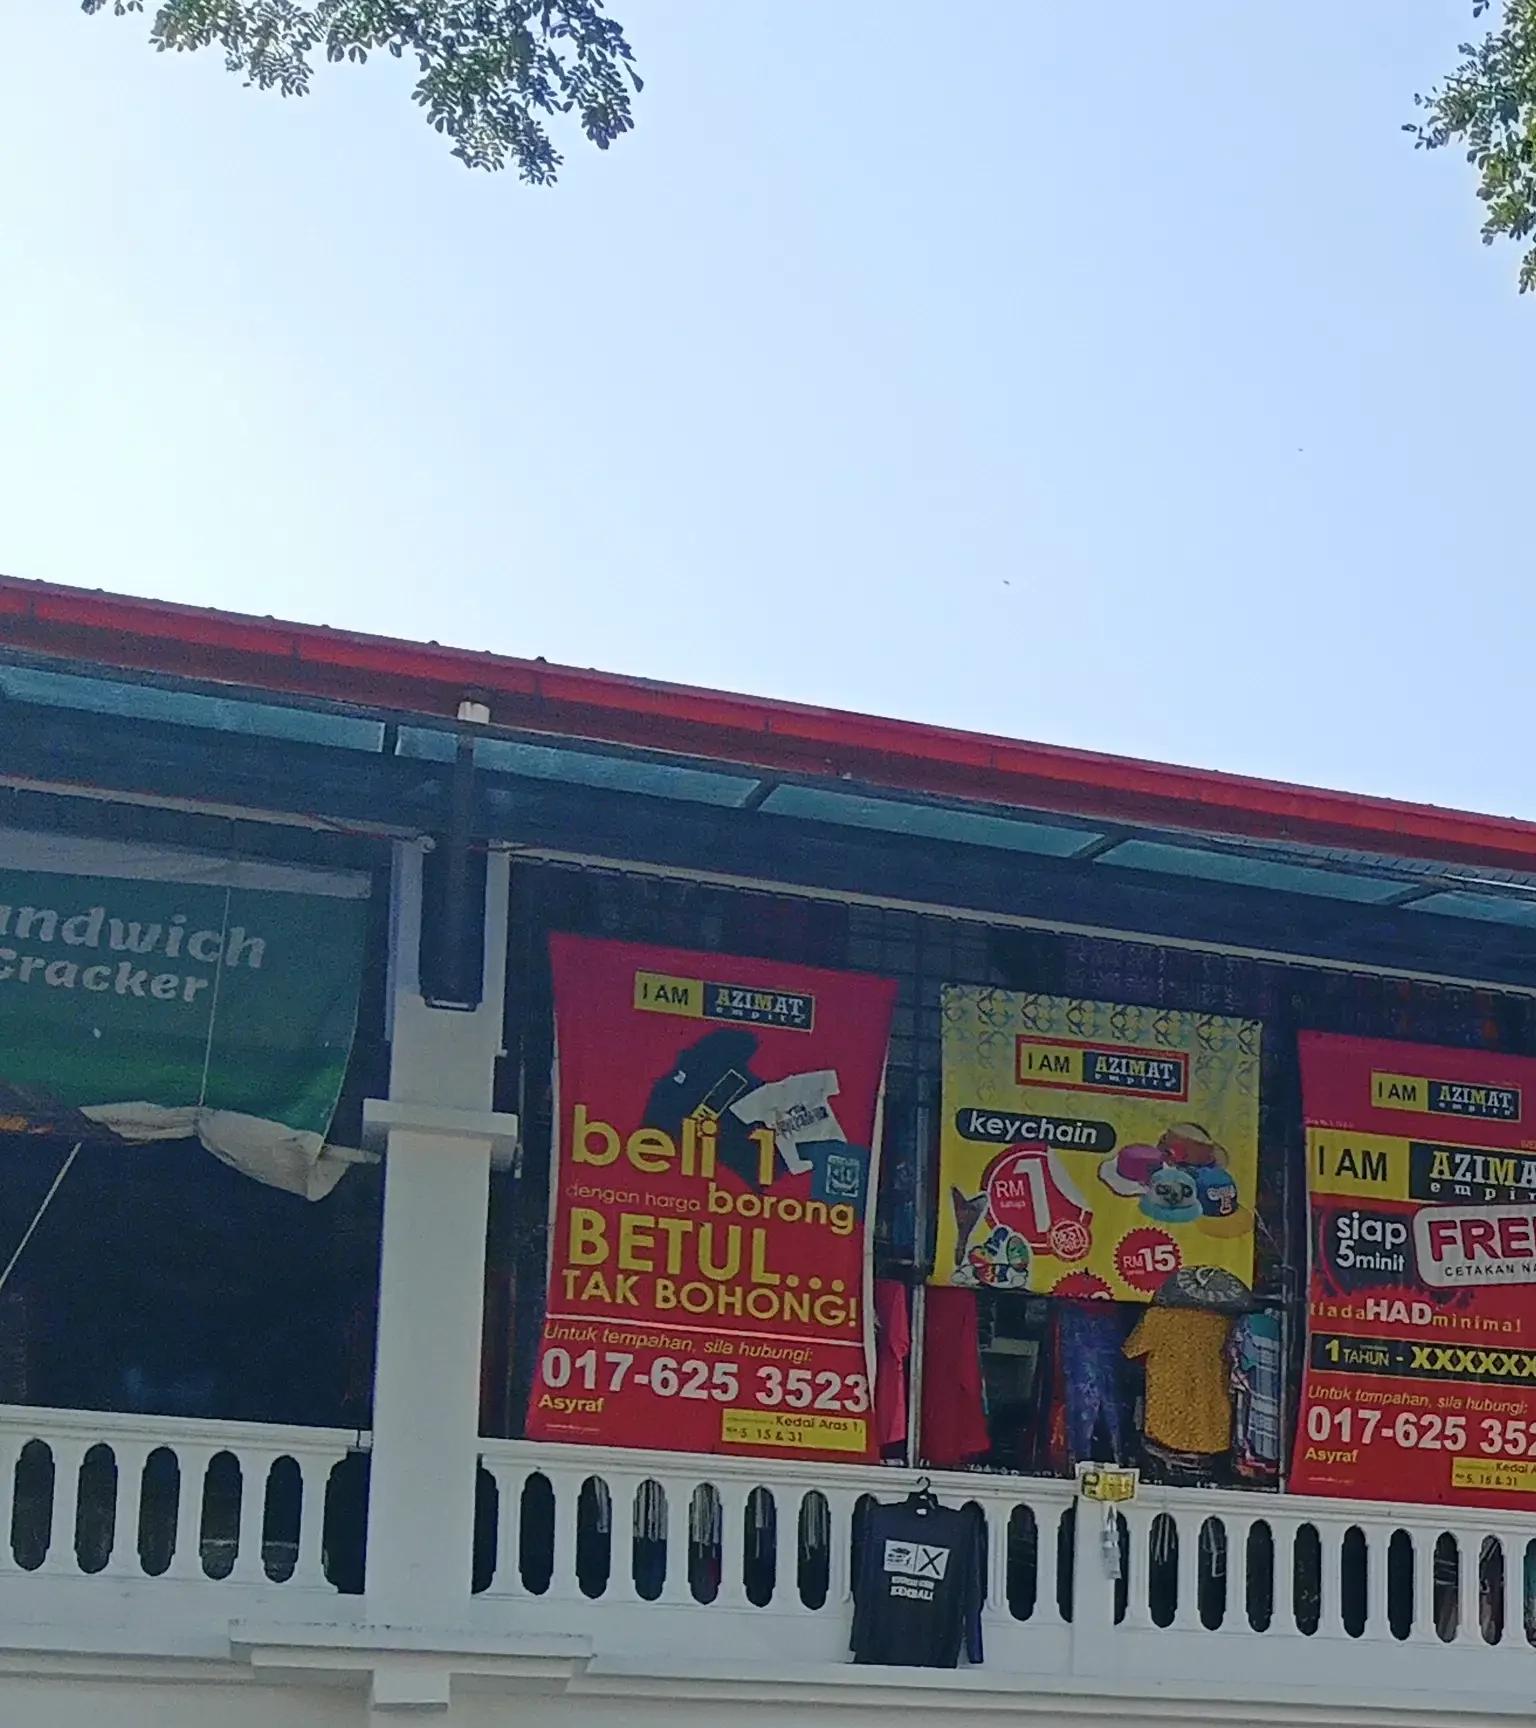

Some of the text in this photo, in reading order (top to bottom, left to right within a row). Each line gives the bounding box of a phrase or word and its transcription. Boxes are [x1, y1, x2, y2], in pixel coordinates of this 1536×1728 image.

[0, 904, 266, 969] ndwich
[654, 984, 689, 1006] AM
[716, 987, 805, 1017] AZIMAT
[1038, 1054, 1071, 1074] AM
[1094, 1055, 1174, 1082] AZIMAT
[1388, 1084, 1417, 1102] AM
[1438, 1084, 1513, 1109] AZIMAT
[968, 1109, 1099, 1145] keychain
[572, 1103, 775, 1186] beli 1
[1317, 1145, 1388, 1183] I AM
[566, 1182, 855, 1235] dengan harga borong
[994, 1156, 1052, 1233] RM 1
[1336, 1211, 1407, 1251] siap
[568, 1206, 846, 1293] BETUL...
[1444, 1262, 1516, 1278] CETAKAN
[562, 1268, 858, 1328] TAK BOHONG!
[543, 1323, 598, 1342] Untuk
[703, 1339, 734, 1356] sila
[738, 1342, 814, 1365] hubungi:
[1325, 1339, 1340, 1363] 1
[1343, 1349, 1390, 1366] TAHUN
[541, 1346, 871, 1413] 017-625 3523
[538, 1393, 605, 1415] Asyraf
[1308, 1384, 1351, 1401] Untuk
[1437, 1396, 1462, 1410] sila
[1466, 1398, 1529, 1417] hubungi:
[775, 1414, 816, 1430] Kedai
[818, 1418, 849, 1431] Aras
[1307, 1404, 1467, 1452] 017-625
[1304, 1447, 1358, 1465] Asyraf
